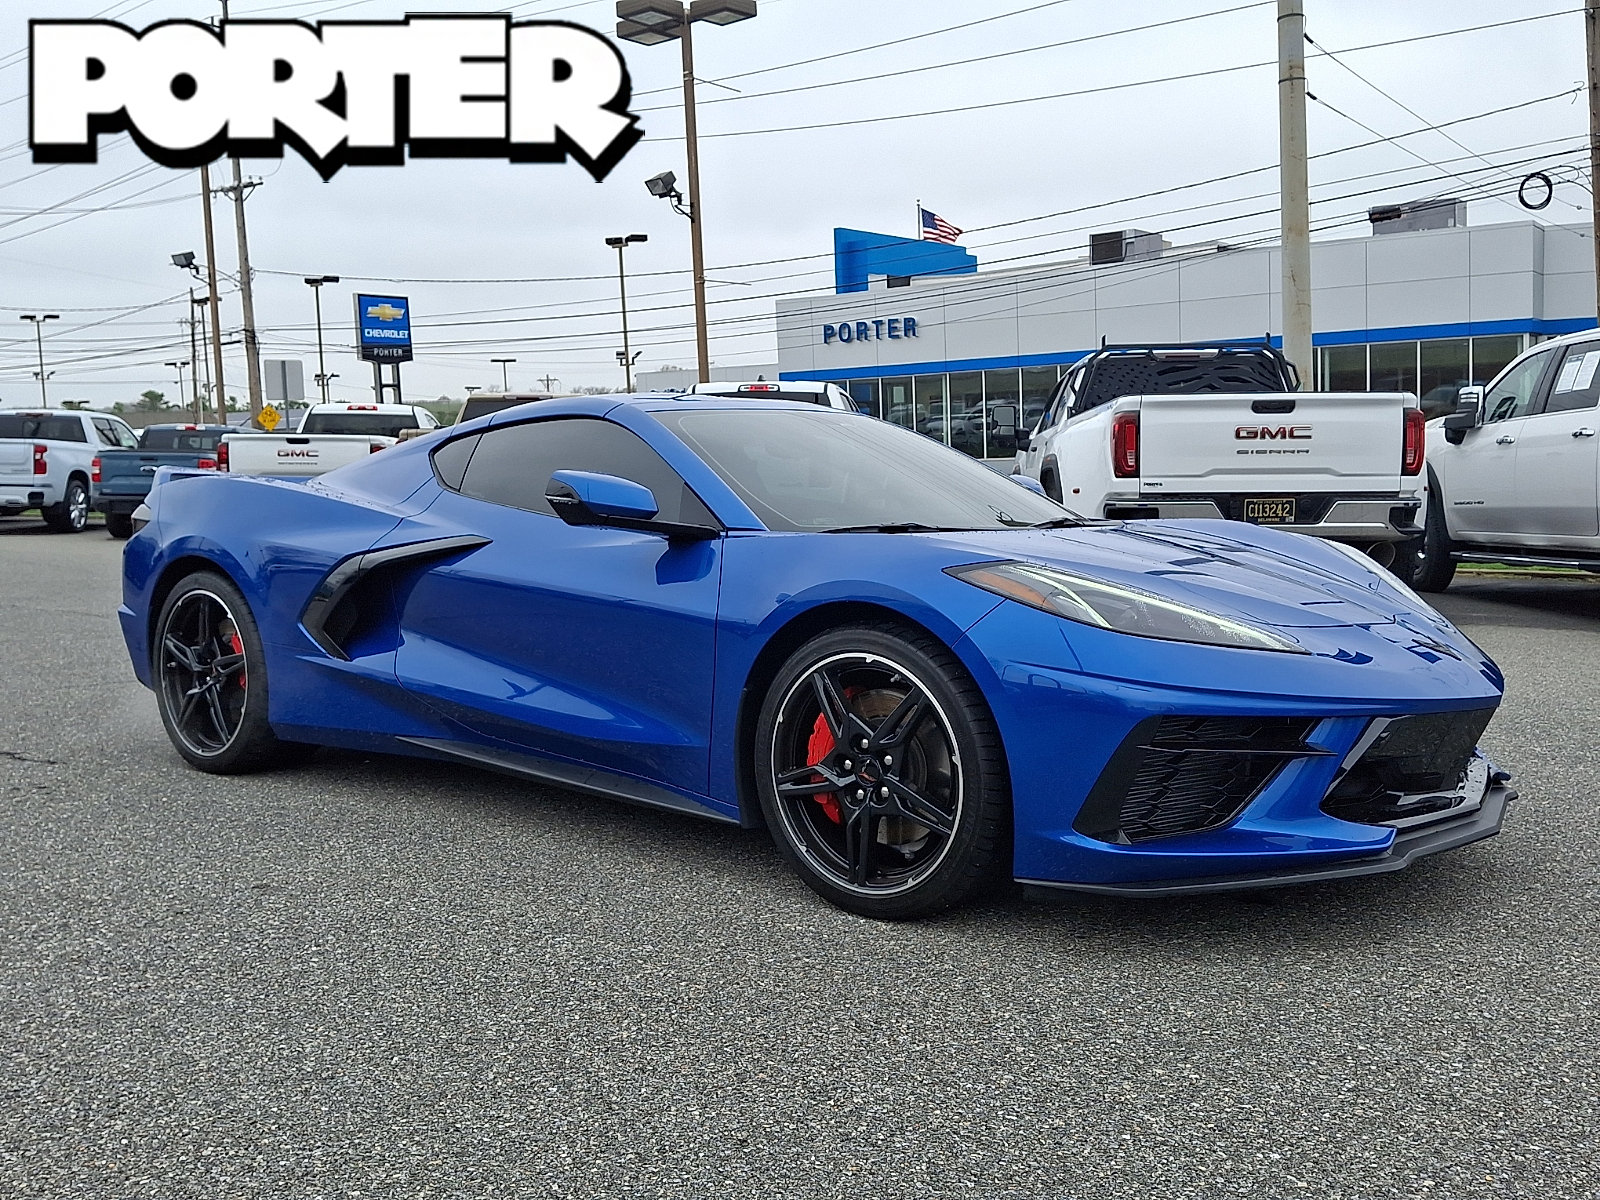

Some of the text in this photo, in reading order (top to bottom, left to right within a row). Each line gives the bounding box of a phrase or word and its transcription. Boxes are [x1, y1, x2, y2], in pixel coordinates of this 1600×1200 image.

[364, 328, 409, 339] CHEVROLET
[823, 317, 919, 344] PORTER
[373, 347, 403, 357] PORTER
[1234, 425, 1313, 440] GMC
[277, 449, 319, 458] GMC
[1248, 503, 1290, 518] C113242
